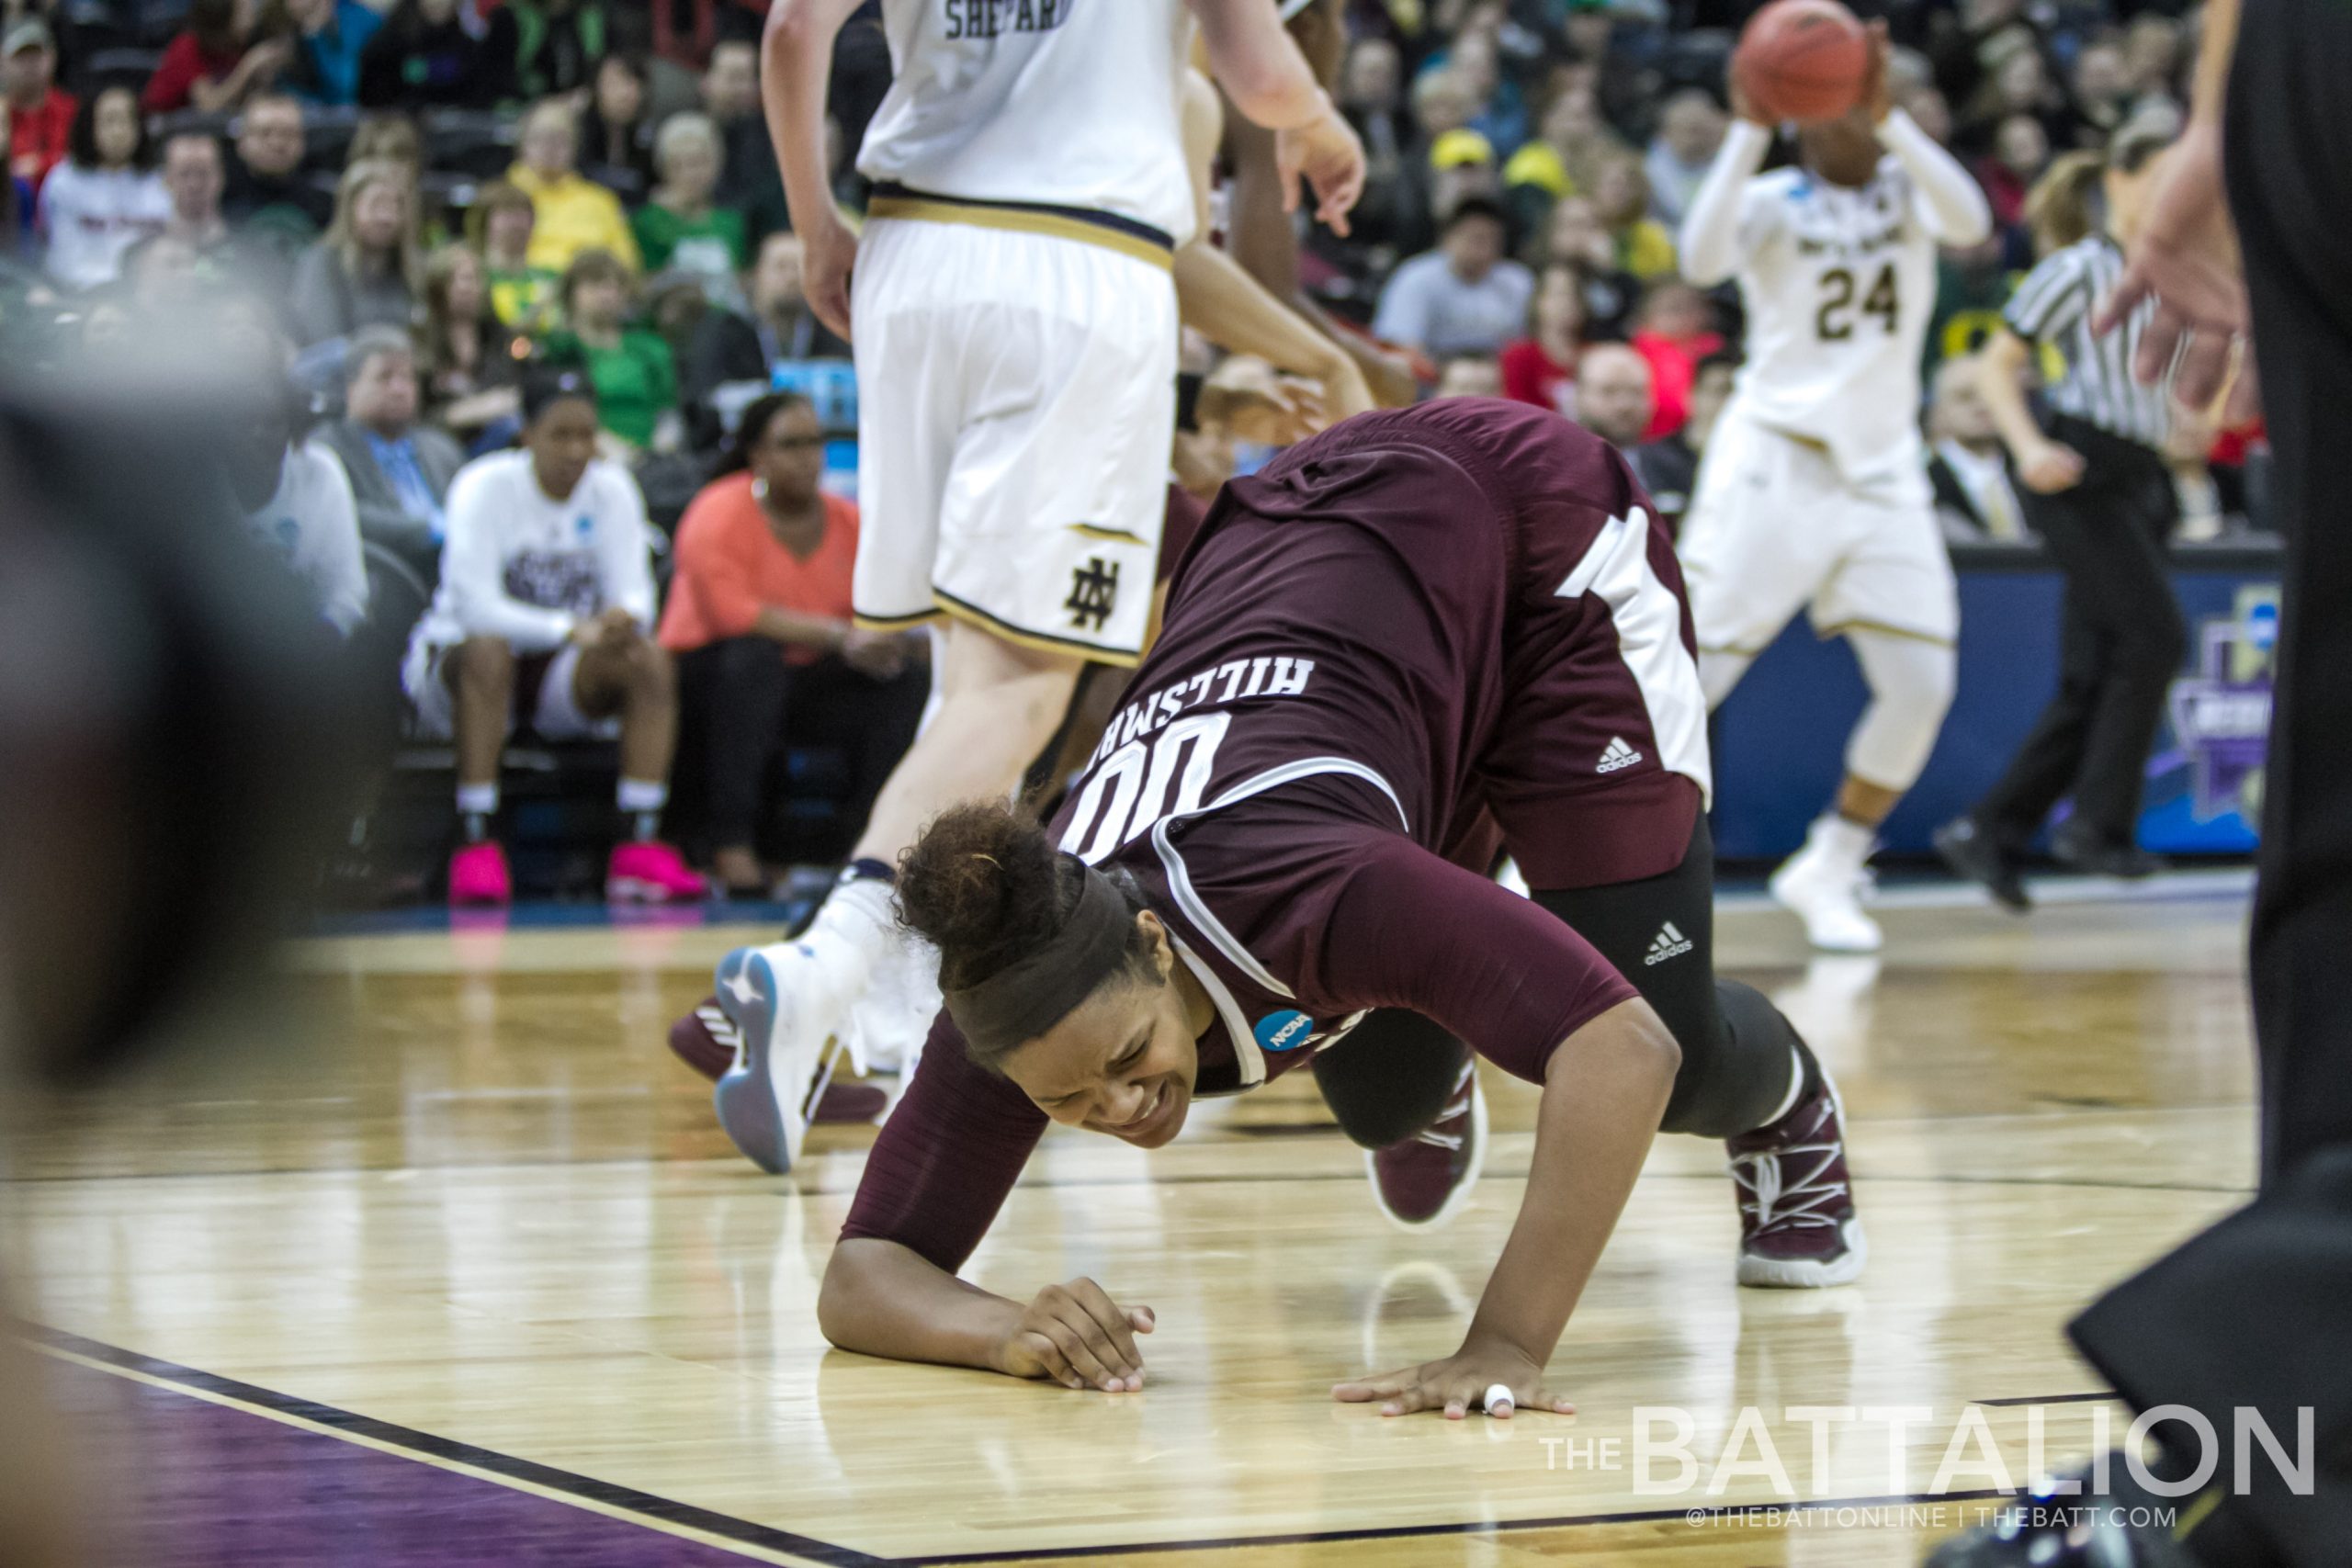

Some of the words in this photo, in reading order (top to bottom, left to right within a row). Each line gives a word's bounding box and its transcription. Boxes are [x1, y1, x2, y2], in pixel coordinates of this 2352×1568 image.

[1816, 263, 1899, 342] 24
[1596, 752, 1643, 773] adidas
[1057, 710, 1232, 867] 00
[1645, 940, 1693, 965] adidas
[1269, 1013, 1312, 1047] NCAA
